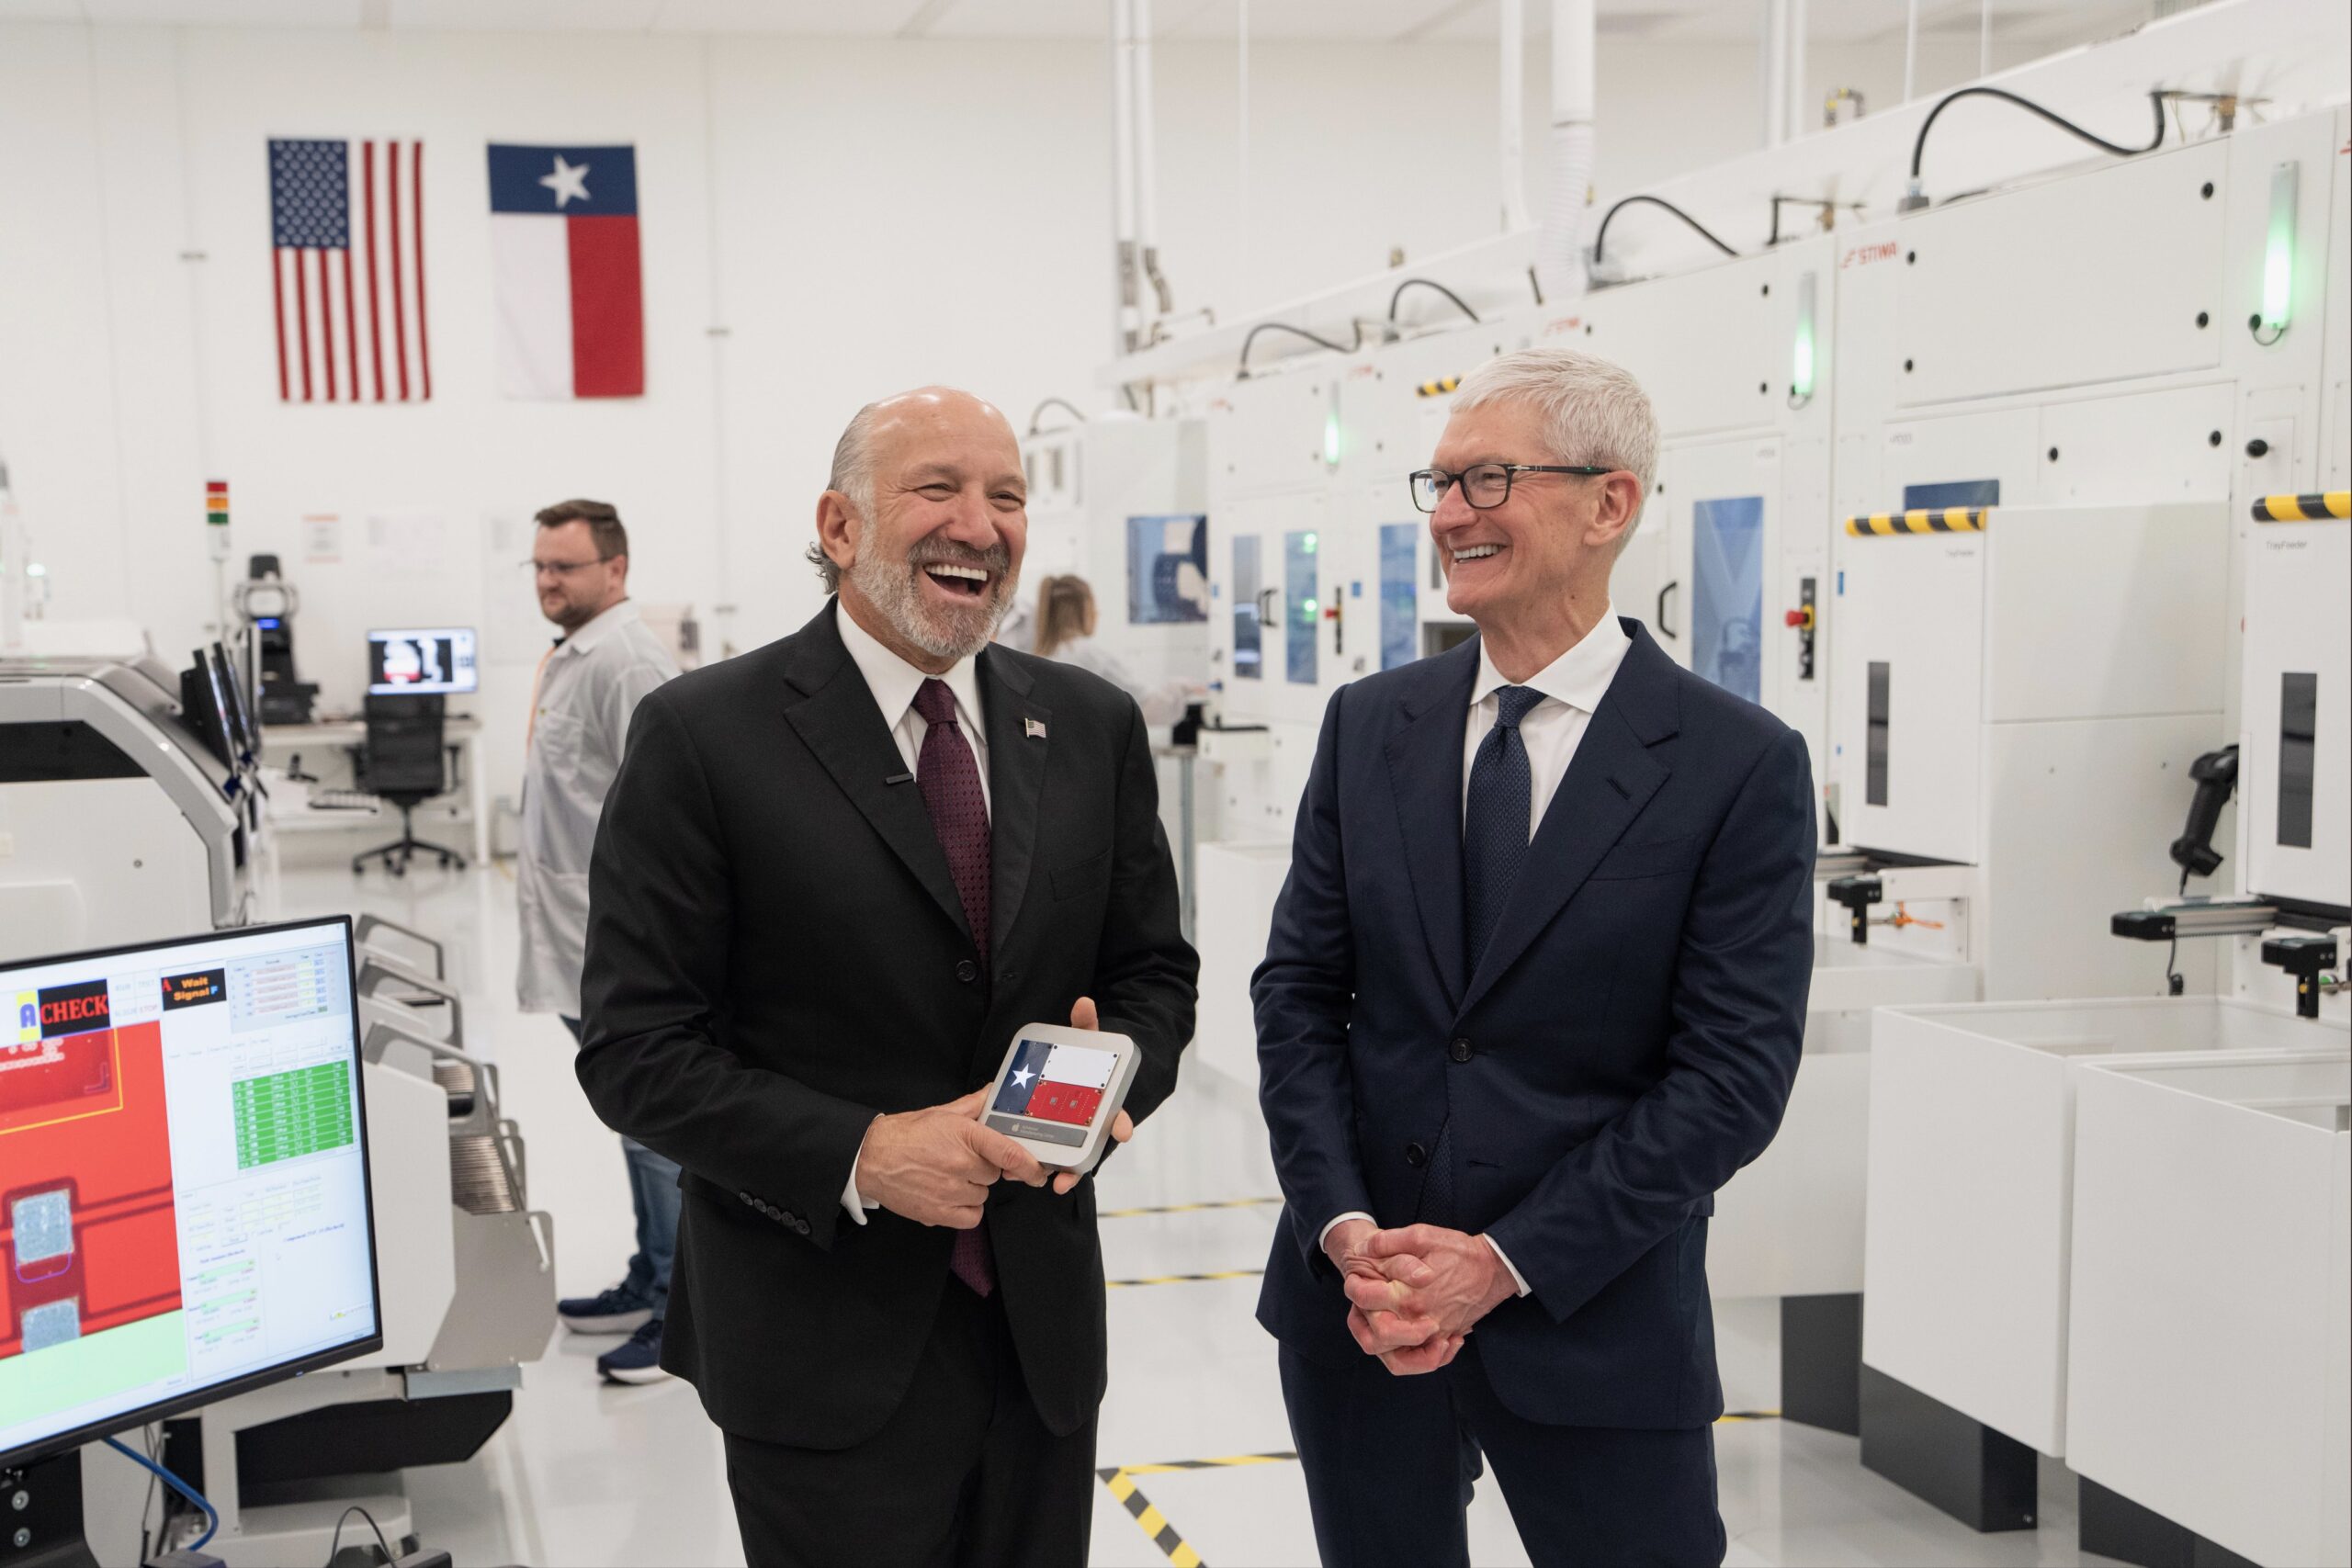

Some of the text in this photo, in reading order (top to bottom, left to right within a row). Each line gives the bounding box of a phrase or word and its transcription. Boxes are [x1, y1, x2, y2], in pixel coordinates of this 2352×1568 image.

[1859, 243, 1897, 264] STIWA
[163, 978, 172, 992] A
[181, 976, 207, 988] Wait
[174, 987, 209, 999] Signal
[20, 1003, 36, 1028] A
[40, 994, 108, 1024] CHECK
